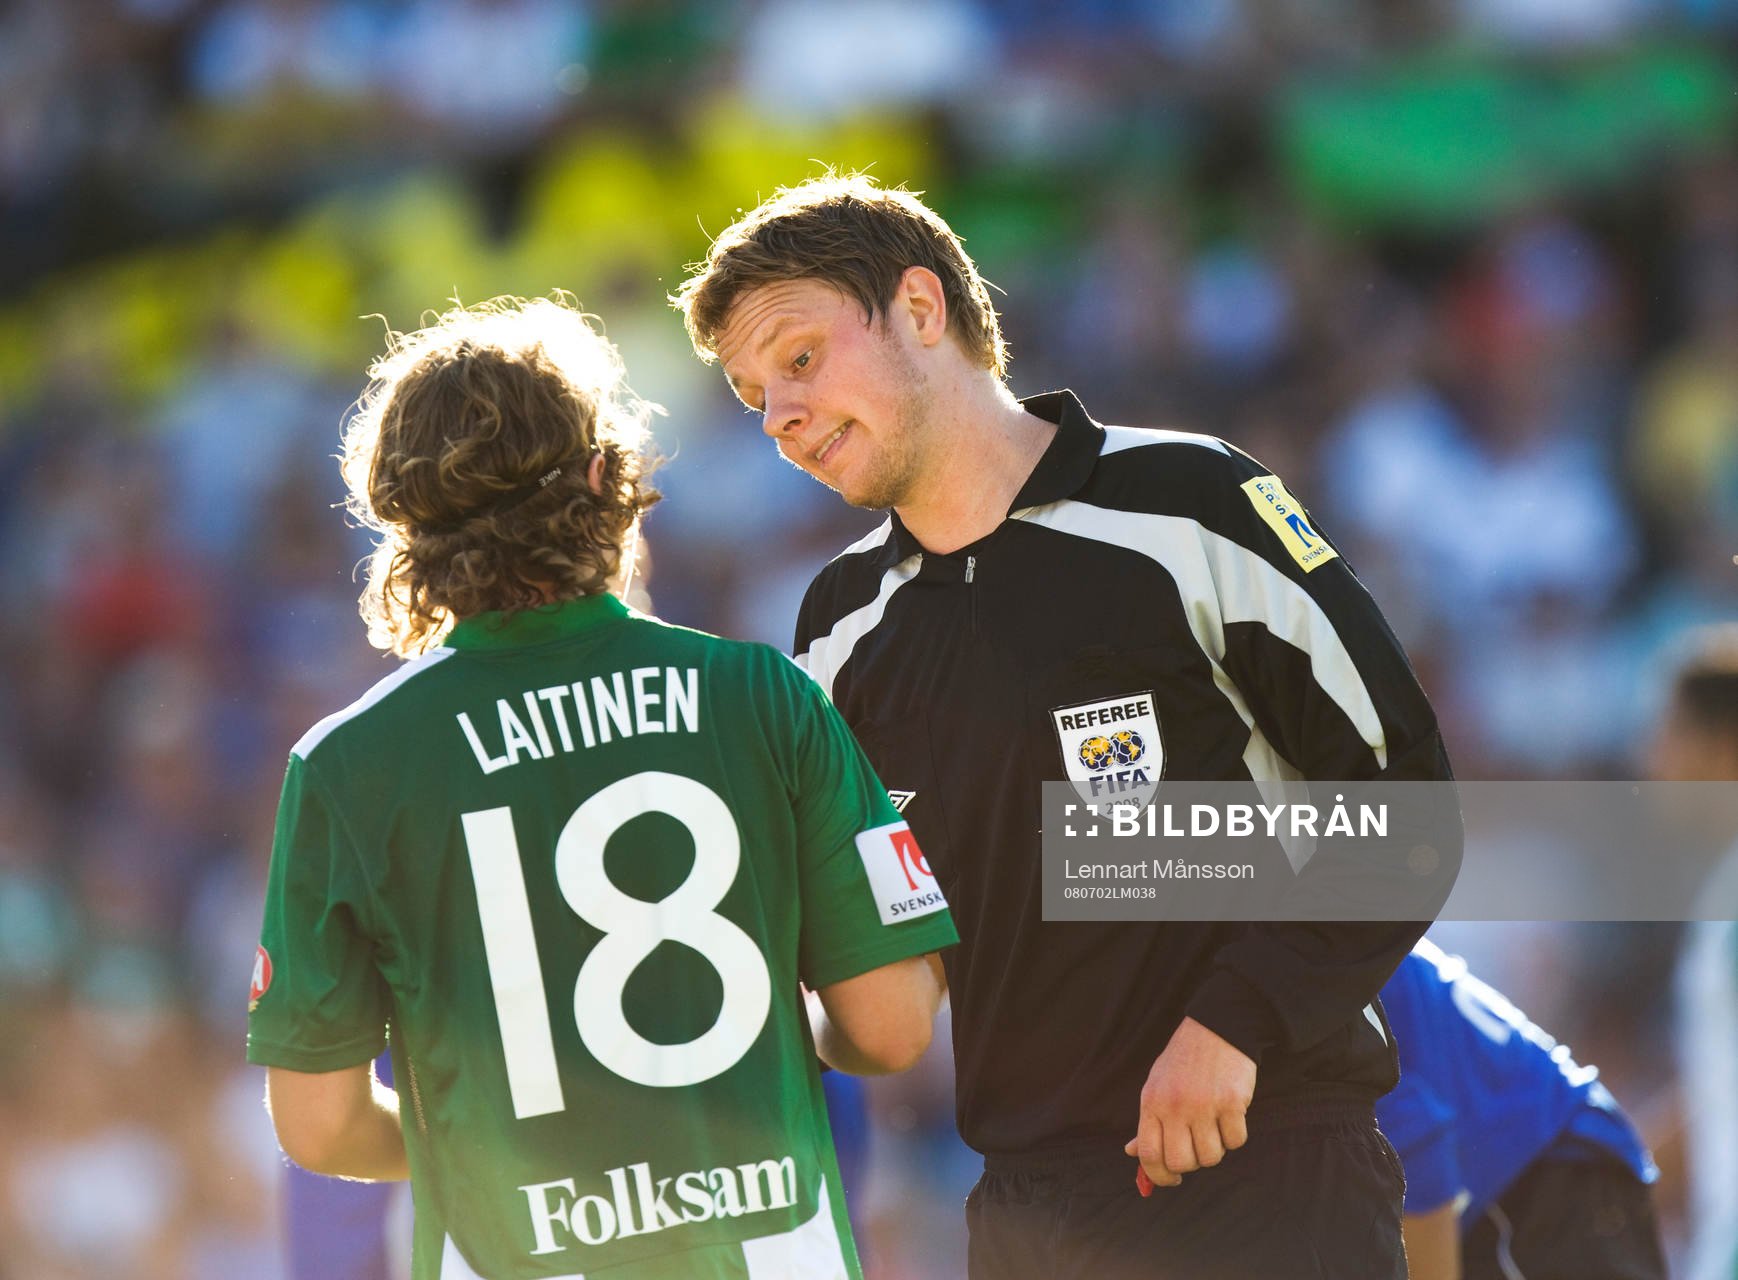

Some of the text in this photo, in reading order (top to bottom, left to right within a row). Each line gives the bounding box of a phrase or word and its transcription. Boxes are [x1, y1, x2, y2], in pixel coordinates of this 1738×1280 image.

[457, 667, 699, 775] LAITINEN
[1060, 700, 1150, 731] REFEREE
[1089, 768, 1151, 797] FIFA
[461, 771, 771, 1119] 18
[518, 1156, 798, 1255] Folksam
